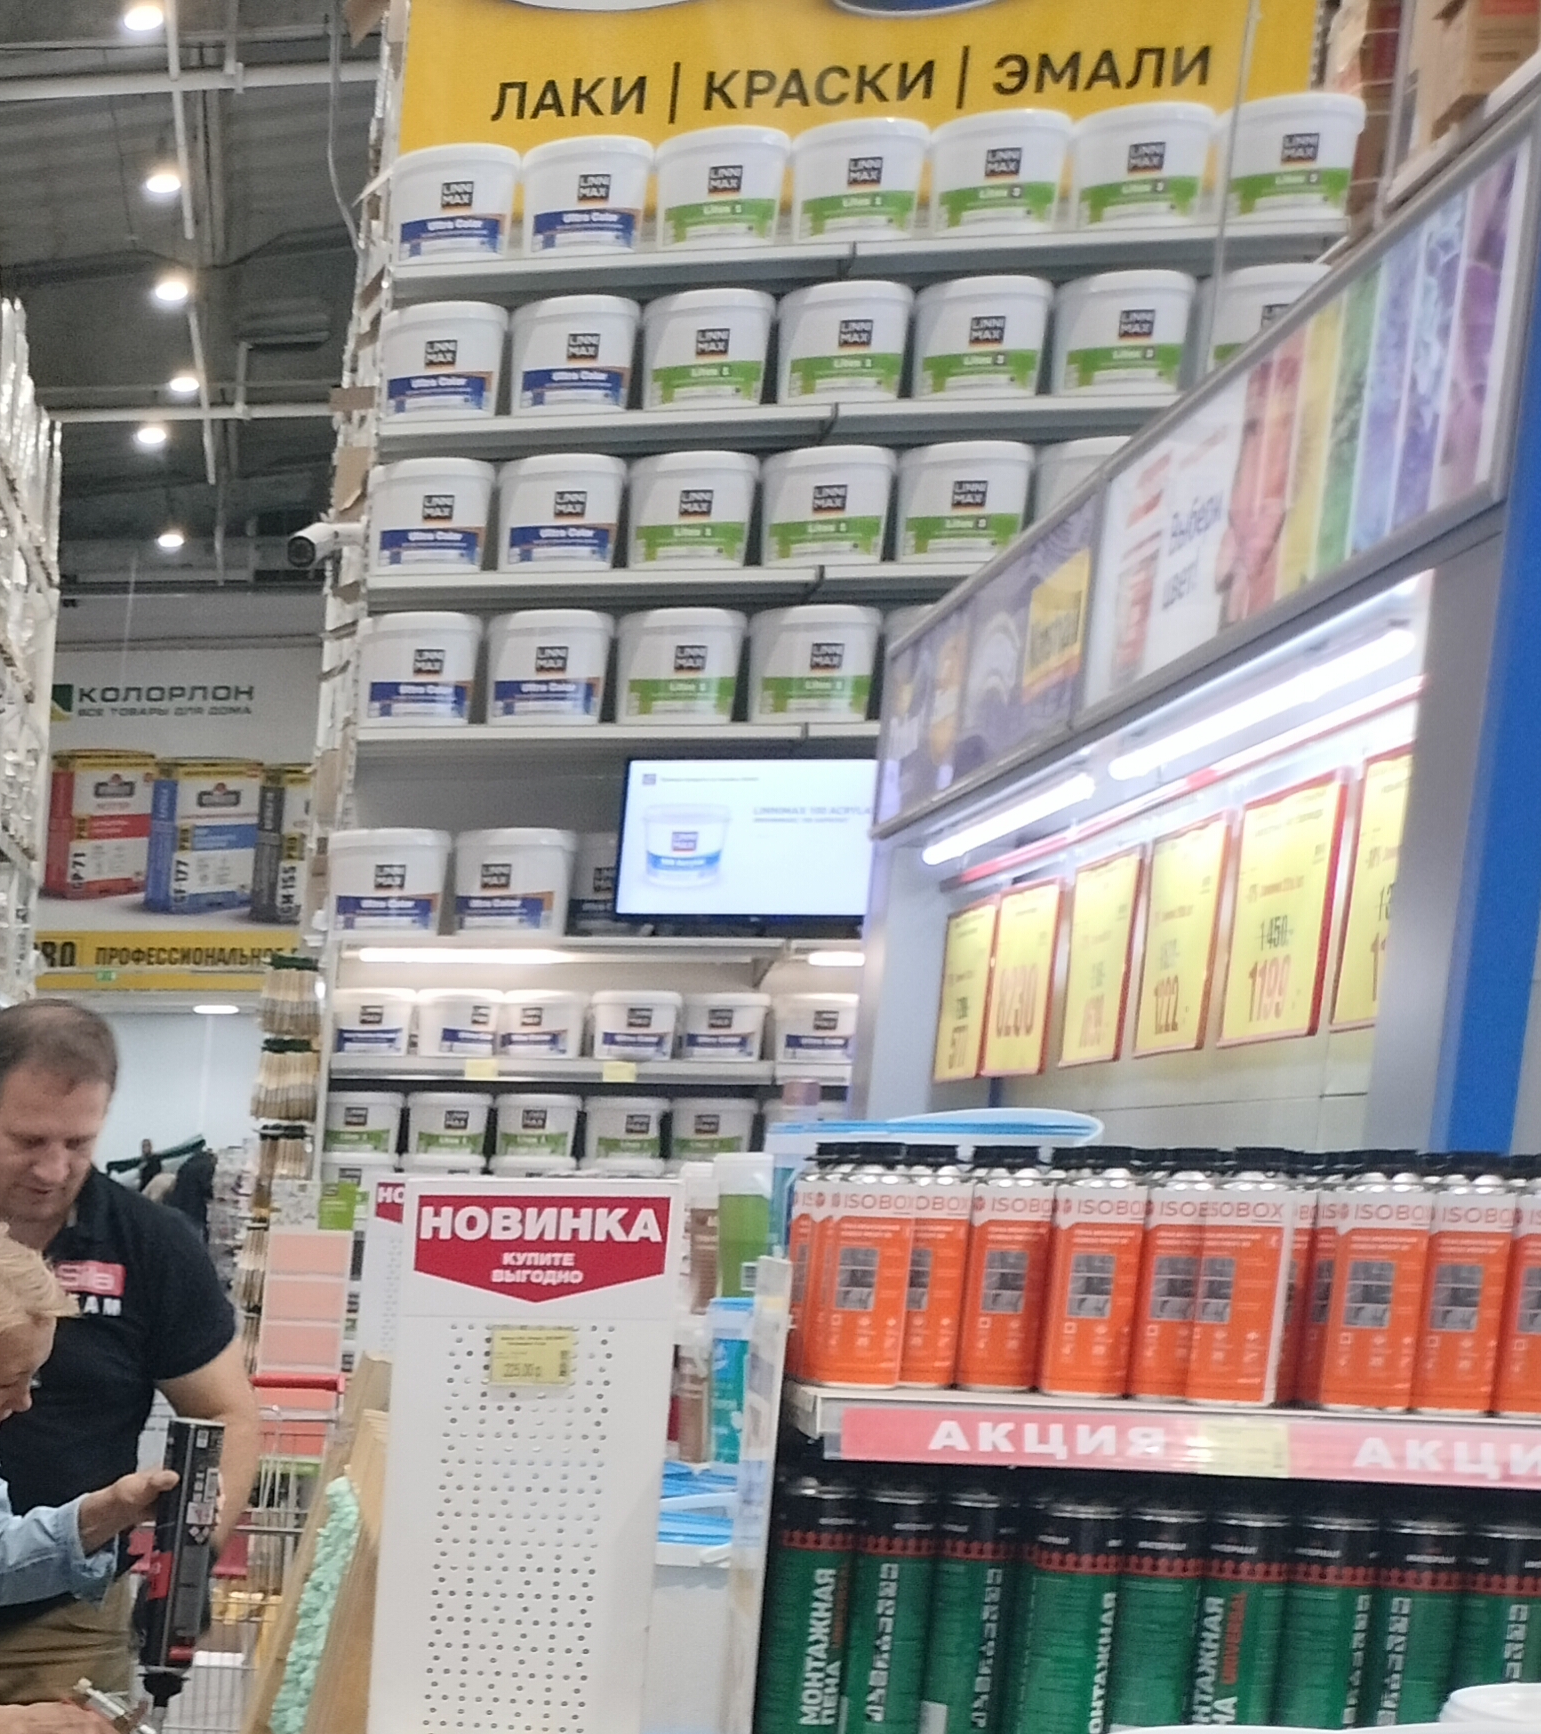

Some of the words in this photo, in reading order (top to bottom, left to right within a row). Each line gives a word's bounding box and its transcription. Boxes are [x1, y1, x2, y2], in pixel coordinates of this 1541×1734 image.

[491, 75, 648, 122] ЛАКИ
[703, 58, 935, 111] КРАСКИ
[993, 44, 1212, 95] ЭМАЛИ
[987, 149, 1022, 162] LINNI
[850, 159, 883, 172] LINNI
[987, 161, 1020, 175] MAX
[849, 170, 882, 184] MAX
[840, 320, 874, 333] LINNI
[839, 332, 873, 346] MAX
[78, 685, 254, 703] КОЛОРЛОН
[1077, 1199, 1144, 1216] ISOBO
[1207, 1201, 1285, 1219] SOBOX
[1354, 1203, 1426, 1221] ISOBO
[1442, 1206, 1513, 1224] ISOBO
[420, 1206, 663, 1243] НОВИНКА
[502, 1251, 575, 1268] КУПИТЕ
[491, 1268, 584, 1286] ВЫГОДНО
[929, 1421, 1166, 1457] АКЦИЯ
[1354, 1437, 1541, 1478] АКЦИ
[798, 1568, 836, 1726] МОНТАЖНАЯ
[1192, 1597, 1225, 1724] НТАЖНАЯ
[819, 1660, 842, 1726] ПЕНА
[1213, 1696, 1238, 1725] НА
